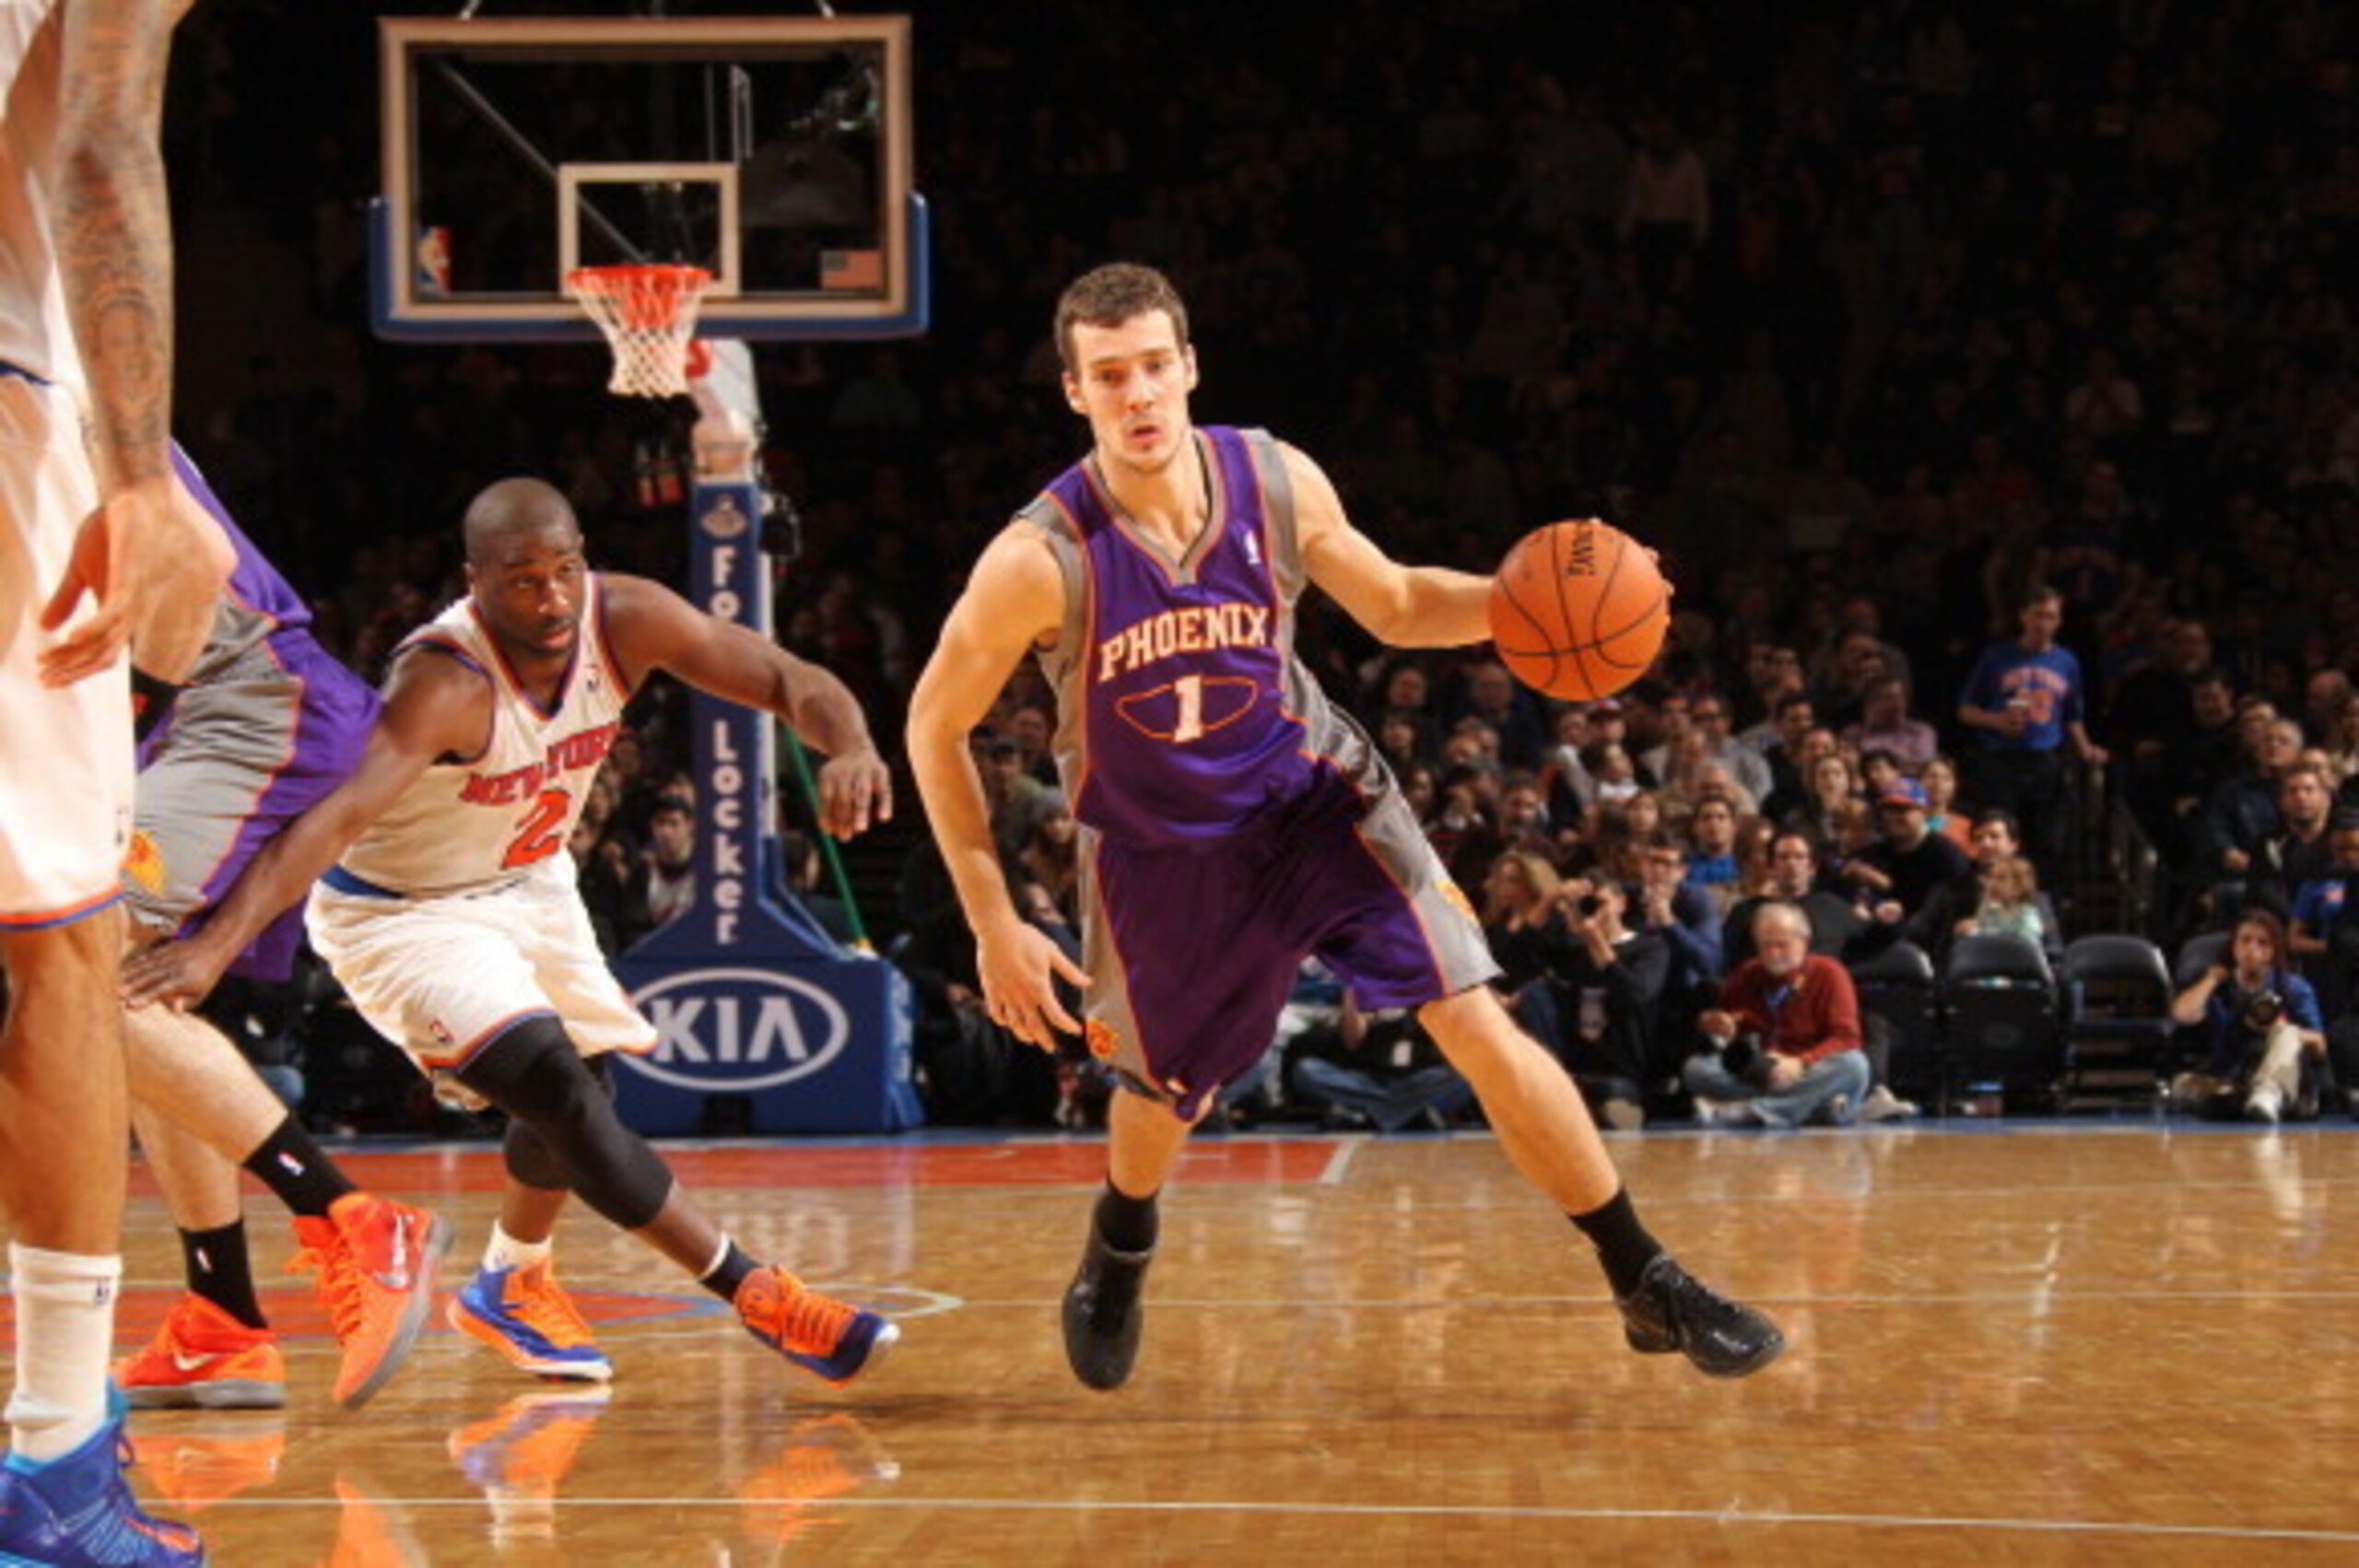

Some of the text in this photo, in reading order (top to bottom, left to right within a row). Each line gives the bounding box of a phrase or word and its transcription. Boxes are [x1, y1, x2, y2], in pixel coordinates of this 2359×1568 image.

[710, 545, 739, 620] Fo
[1098, 603, 1269, 683] PHOENIX
[1173, 674, 1203, 743] 1
[458, 763, 544, 805] NEW
[500, 790, 571, 870] 2
[651, 996, 808, 1061] KIA
